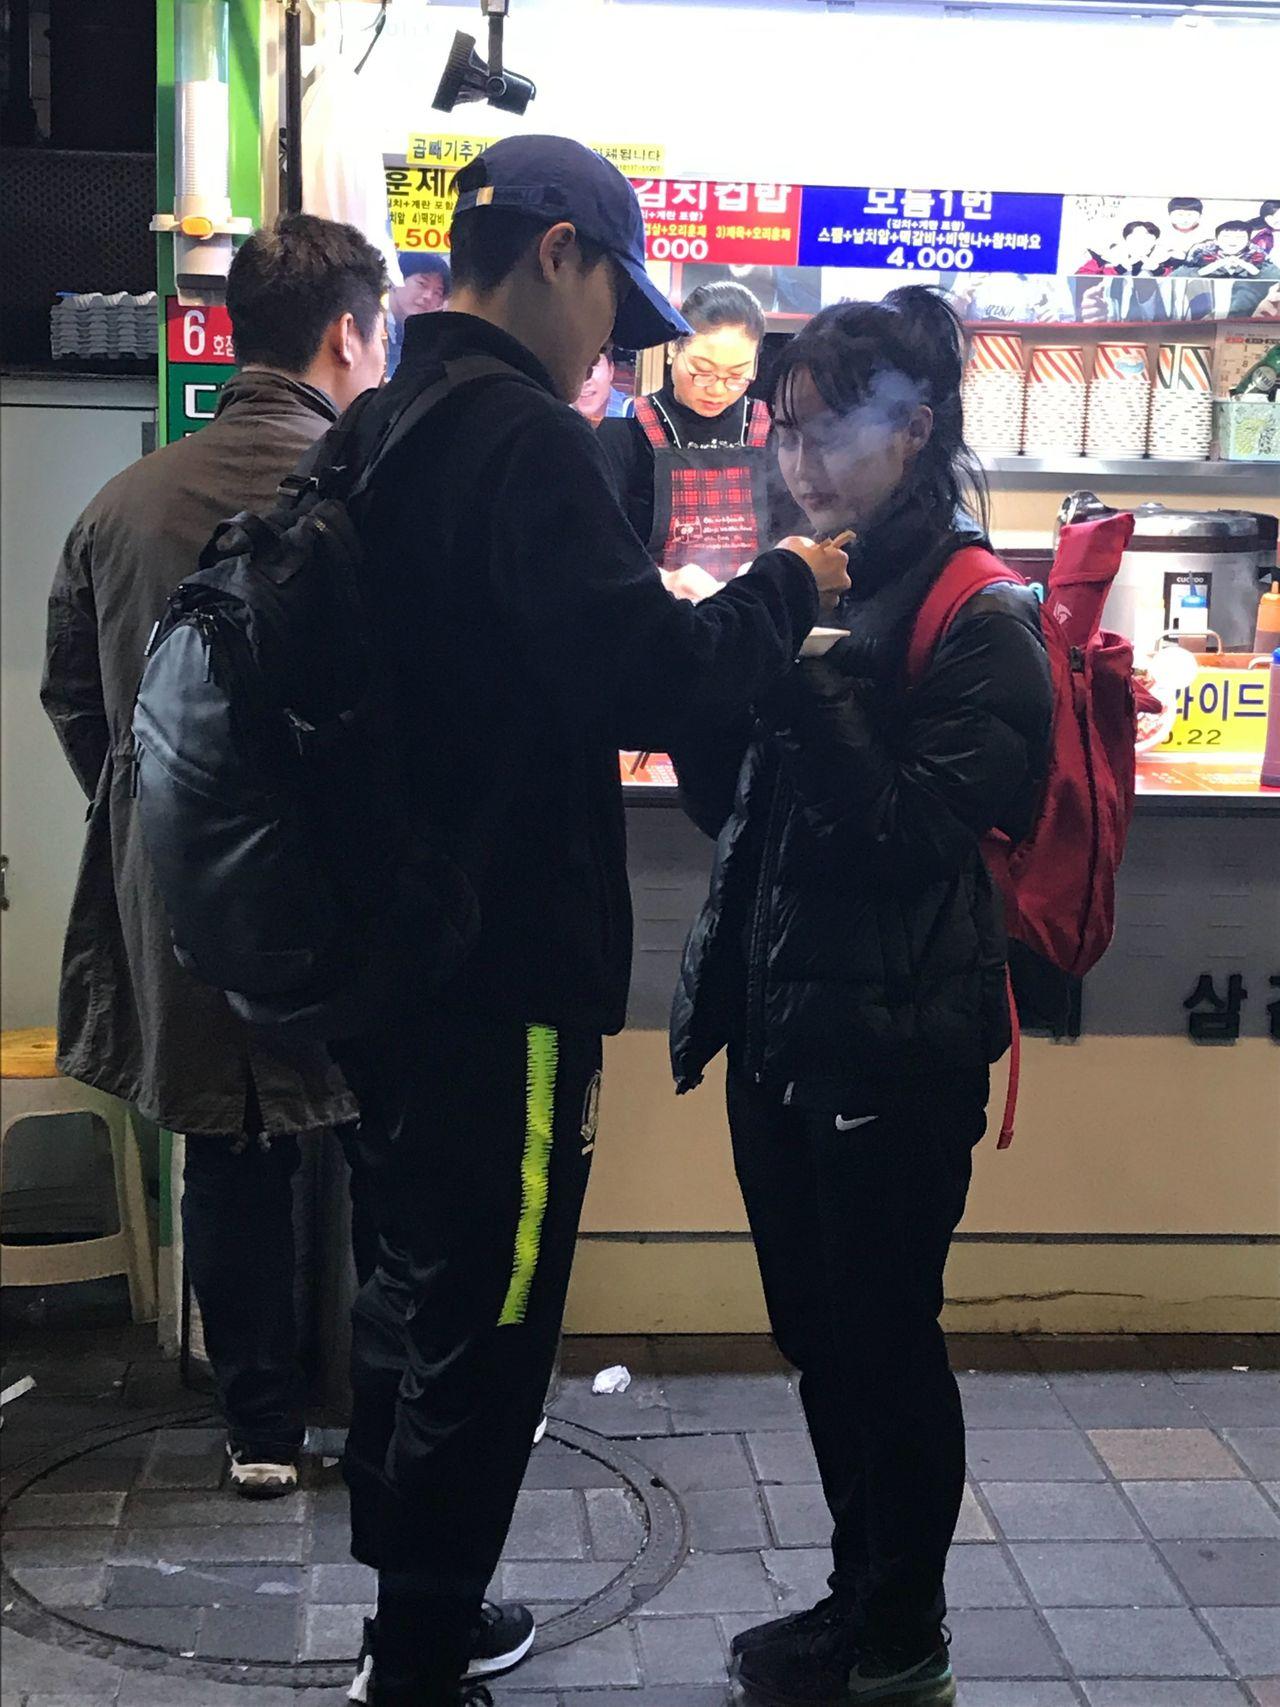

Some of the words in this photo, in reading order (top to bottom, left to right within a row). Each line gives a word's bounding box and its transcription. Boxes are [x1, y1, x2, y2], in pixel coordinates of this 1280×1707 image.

[385, 166, 459, 198] 훈제
[886, 246, 975, 270] 4,000
[183, 309, 206, 357] 6
[1175, 576, 1205, 584] CUCOO
